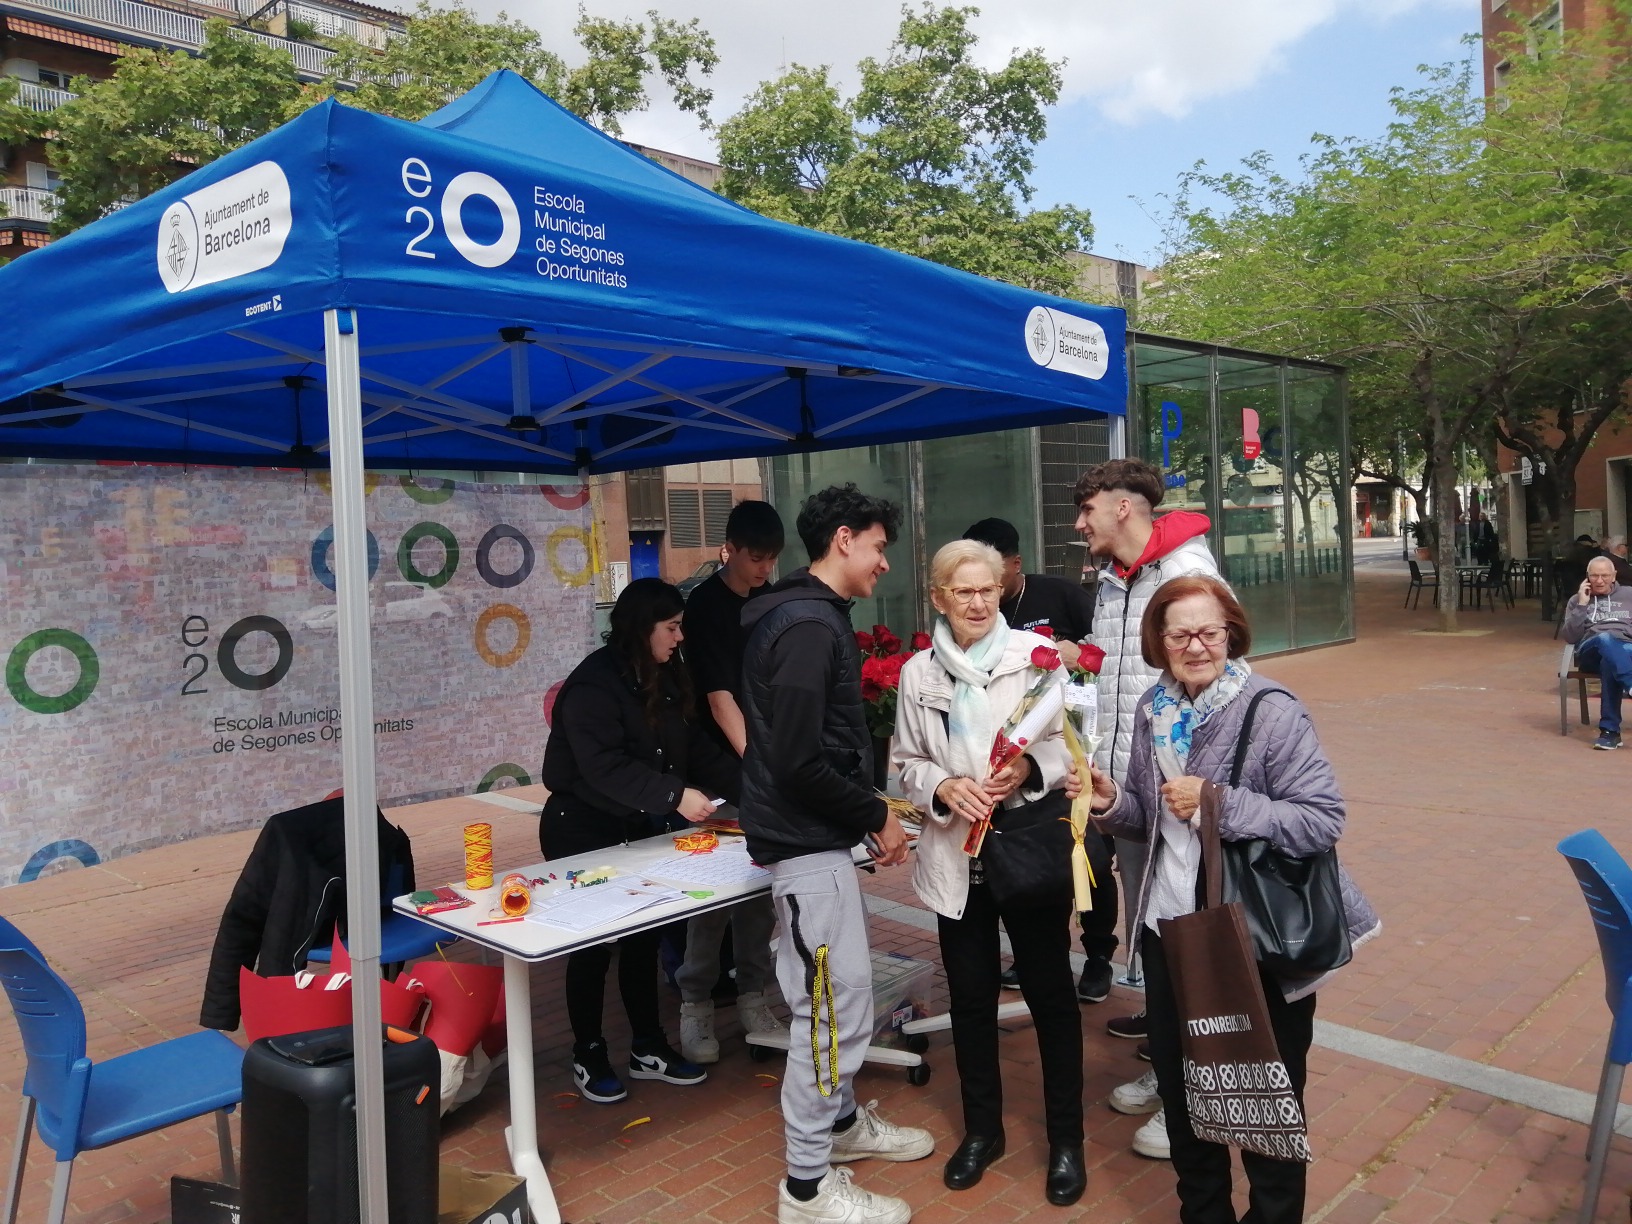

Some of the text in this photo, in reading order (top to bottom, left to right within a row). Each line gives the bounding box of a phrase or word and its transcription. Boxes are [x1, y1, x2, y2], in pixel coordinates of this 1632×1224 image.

[401, 157, 433, 198] e
[204, 188, 270, 230] Ajuntament de
[534, 186, 586, 214] Escola
[205, 217, 271, 256] Barcelona
[534, 210, 606, 241] Municipal
[535, 235, 625, 266] de Segones
[536, 257, 628, 289] Oportunitats
[245, 301, 273, 316] ECOTENT
[1059, 326, 1098, 346] Ajuntament de
[1059, 340, 1098, 363] Barcelona
[181, 615, 209, 648] e
[1023, 618, 1050, 630] FUTURE
[212, 717, 414, 754] de Segones Opnitats
[214, 706, 342, 734] Escola Municip
